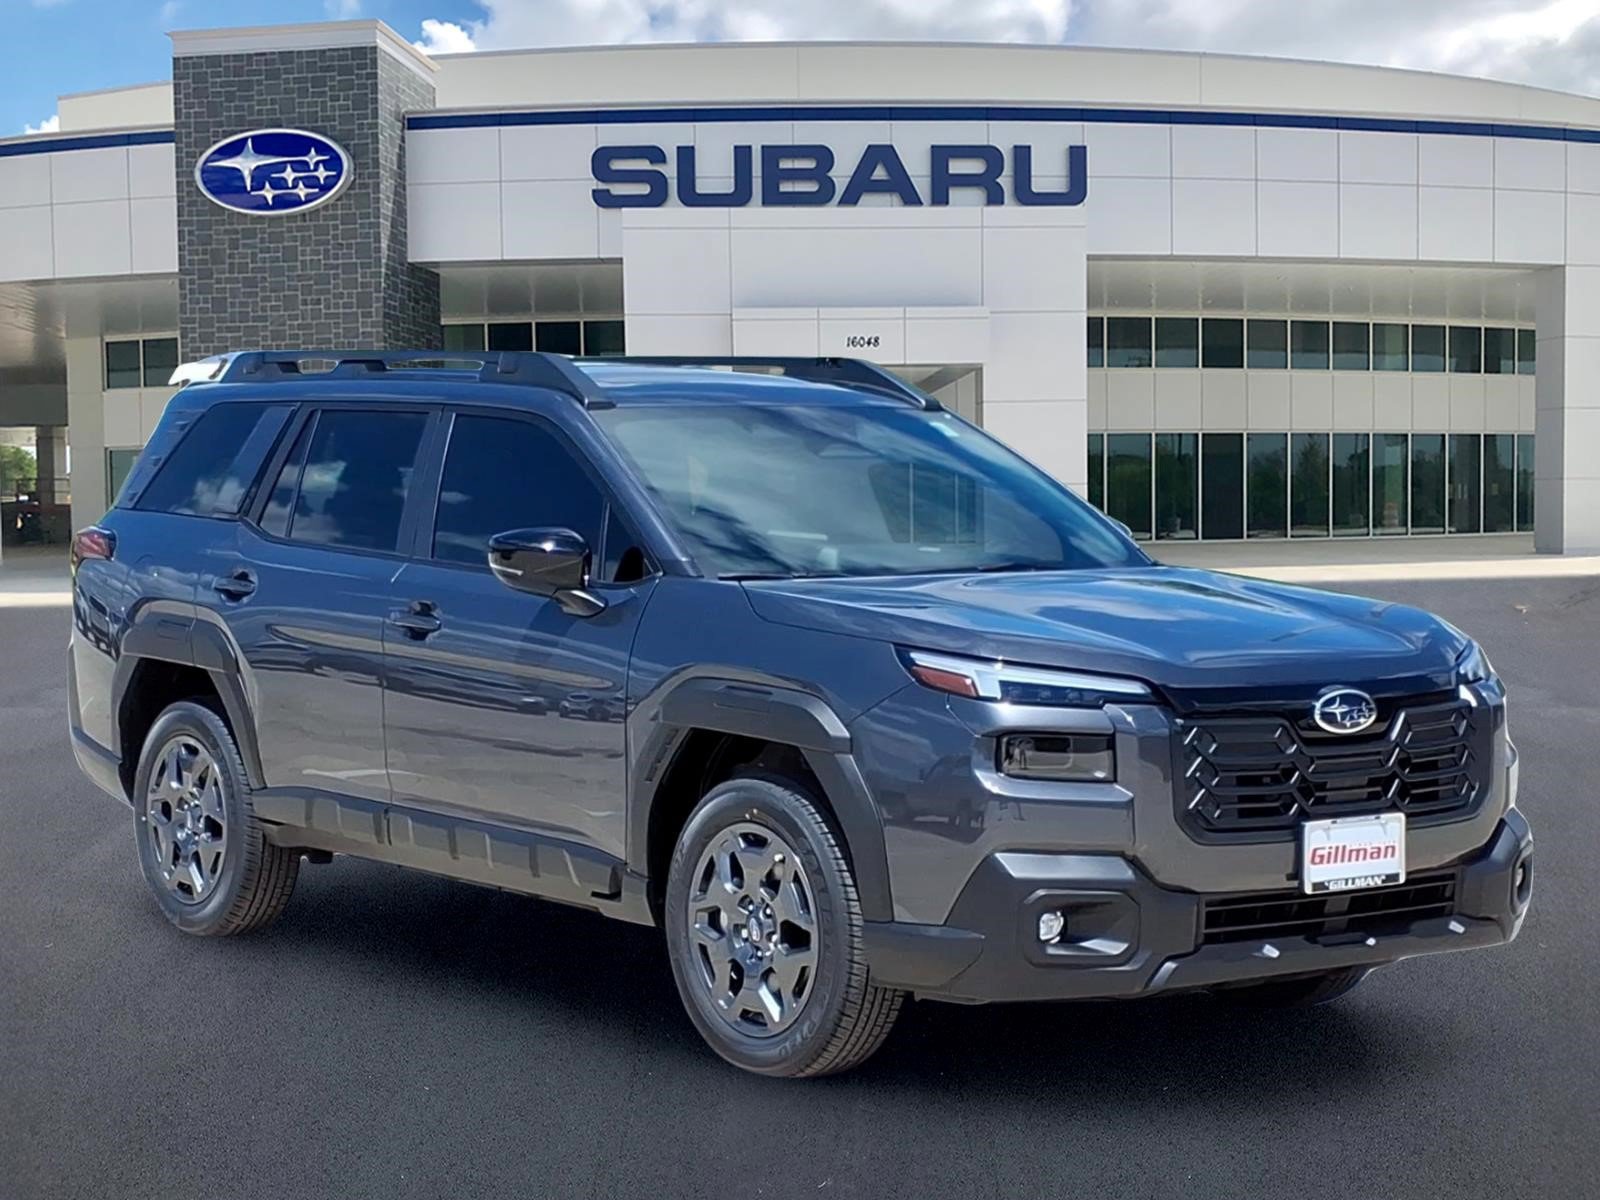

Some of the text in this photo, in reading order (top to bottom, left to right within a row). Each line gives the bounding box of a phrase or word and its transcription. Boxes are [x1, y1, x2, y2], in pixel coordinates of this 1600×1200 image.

[591, 144, 1087, 208] SUBARU
[846, 335, 880, 348] 16048
[1310, 844, 1396, 866] Gillman
